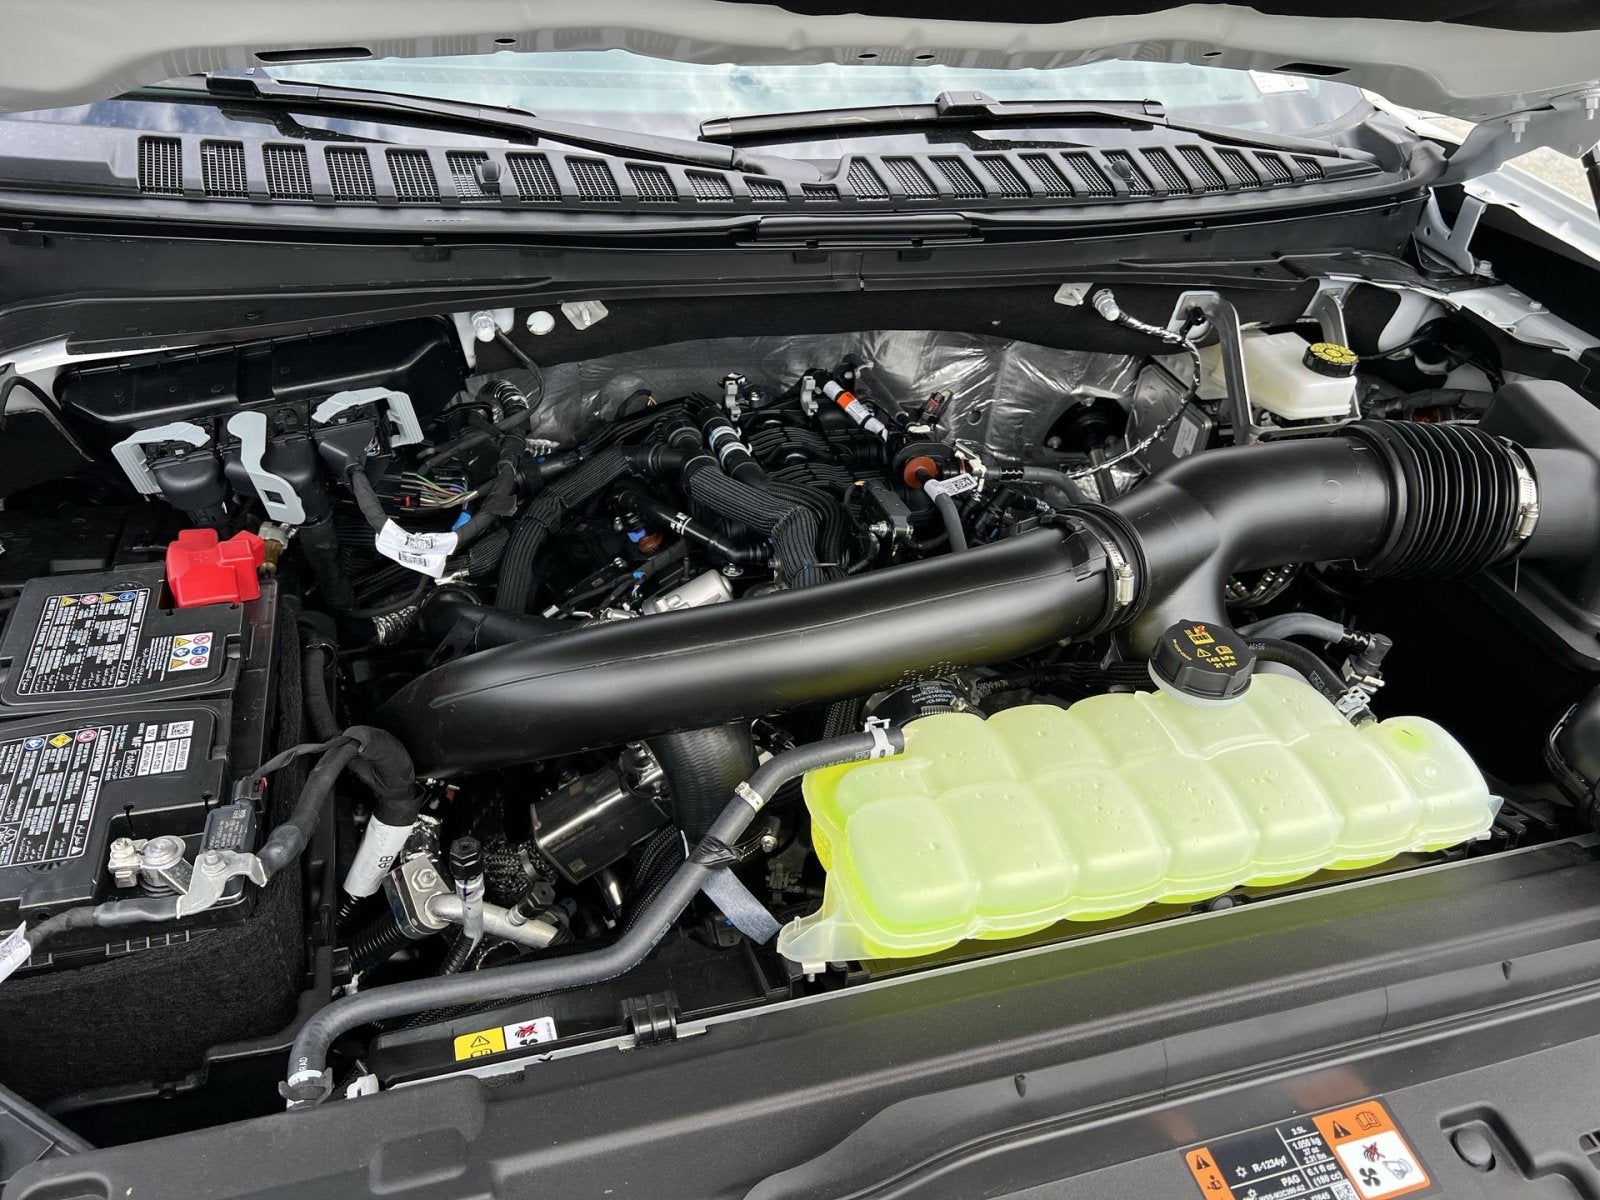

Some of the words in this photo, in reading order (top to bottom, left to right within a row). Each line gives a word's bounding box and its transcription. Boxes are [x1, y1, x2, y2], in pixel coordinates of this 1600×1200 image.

[123, 751, 137, 777] FoMoCo
[1311, 1136, 1322, 1147] kg
[1251, 1155, 1288, 1173] R-1234yf
[1280, 1174, 1301, 1187] PAG
